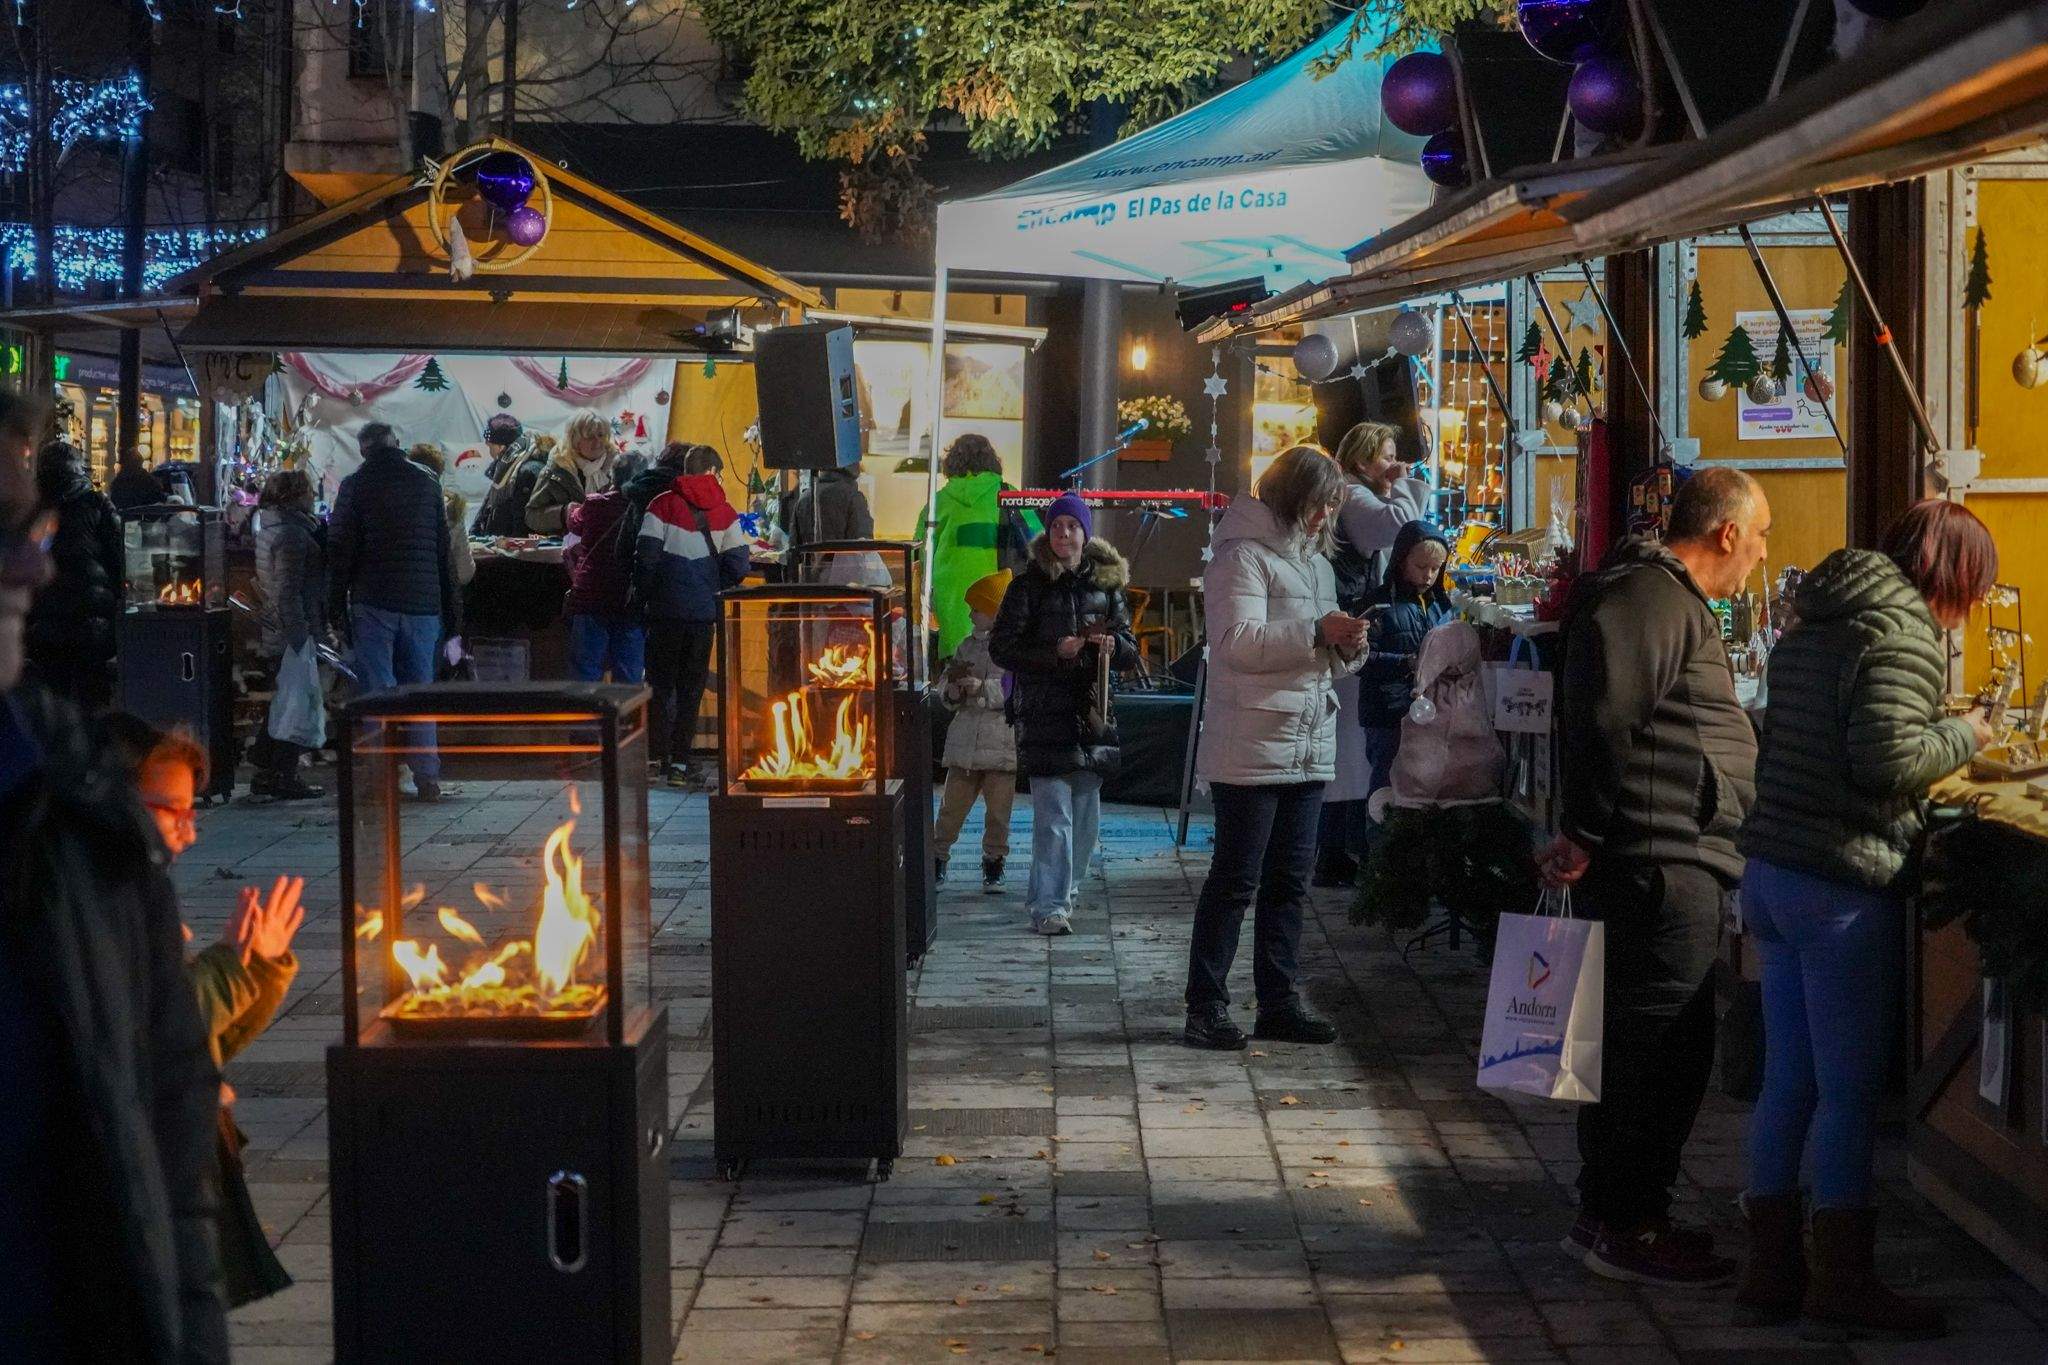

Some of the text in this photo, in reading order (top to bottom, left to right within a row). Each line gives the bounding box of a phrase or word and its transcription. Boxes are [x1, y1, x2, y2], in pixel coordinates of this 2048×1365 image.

[1092, 149, 1283, 180] www.encamp.ad
[1127, 196, 1144, 219] El
[1149, 196, 1182, 217] Pas
[1187, 192, 1212, 212] de
[1217, 190, 1234, 210] la
[1239, 187, 1288, 210] Casa
[1001, 497, 1023, 506] nord
[1506, 995, 1556, 1018] Andorra
